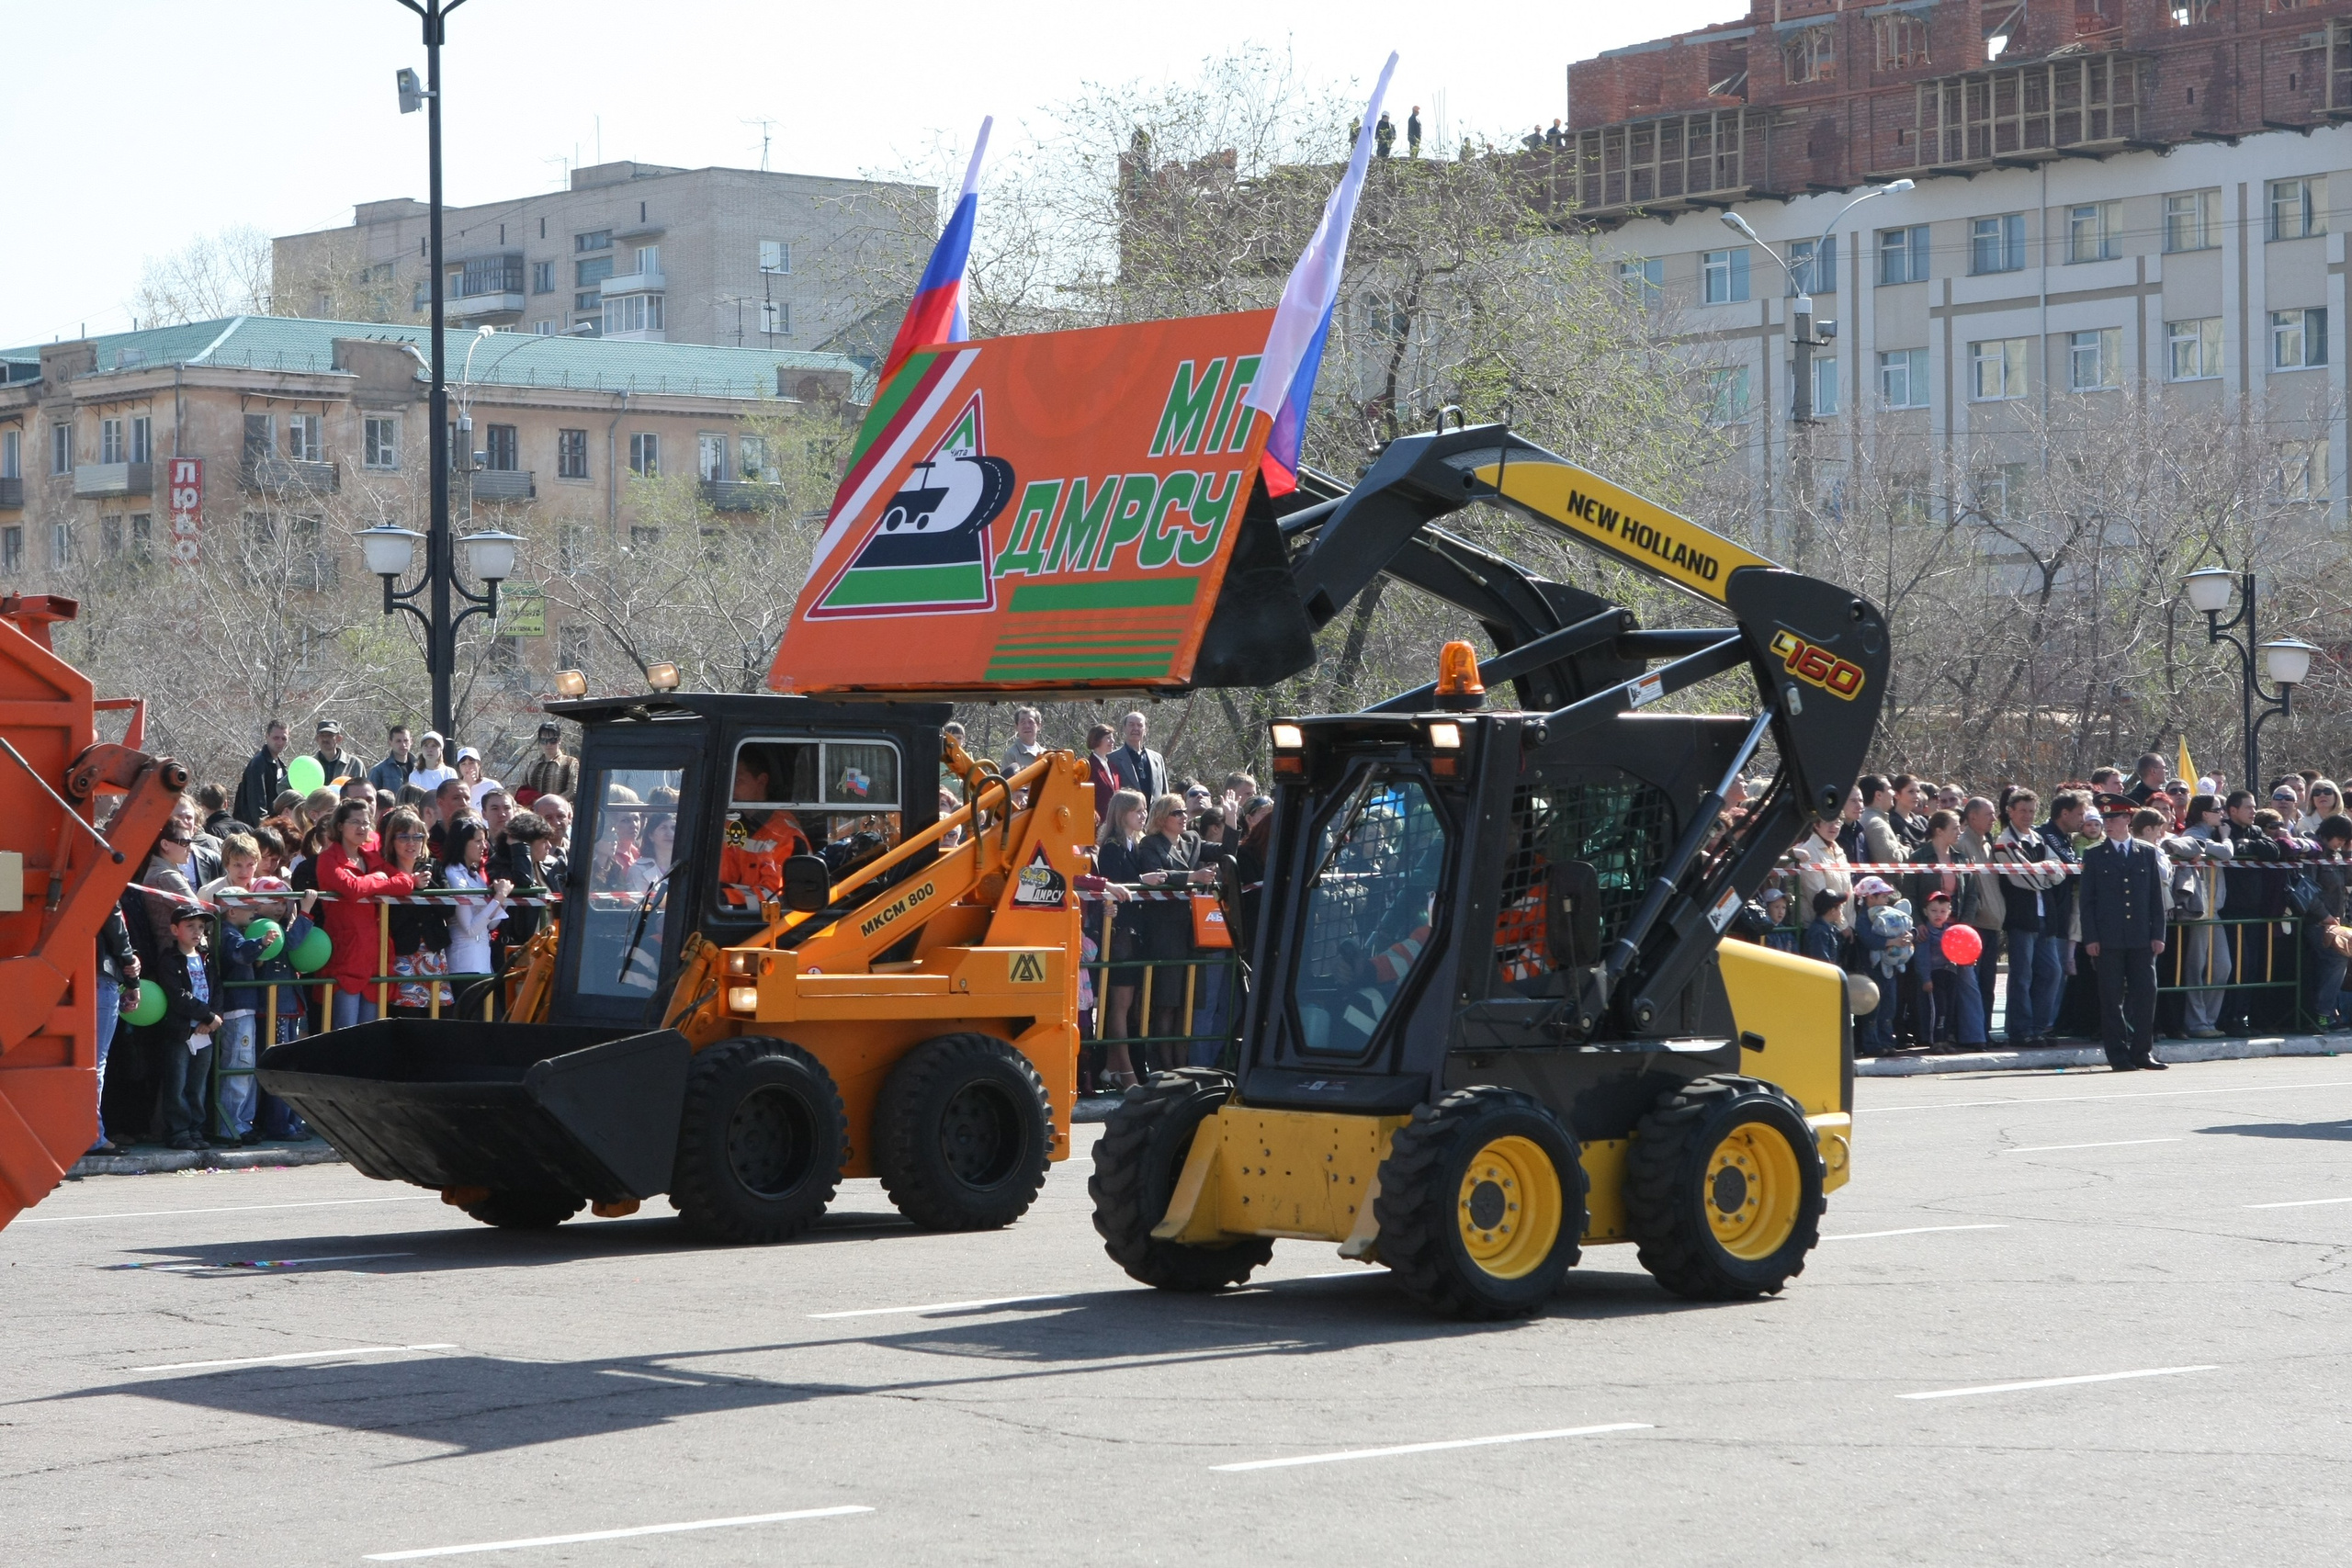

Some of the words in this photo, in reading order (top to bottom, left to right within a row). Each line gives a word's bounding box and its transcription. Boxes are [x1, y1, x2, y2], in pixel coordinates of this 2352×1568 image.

[1148, 353, 1263, 458] МП
[989, 469, 1243, 580] ДМРСУ
[1566, 489, 1620, 533] NEW
[1620, 515, 1719, 581] HOLLAND
[1770, 631, 1864, 698] L160
[860, 899, 907, 937] МКСМ
[908, 883, 934, 907] 800
